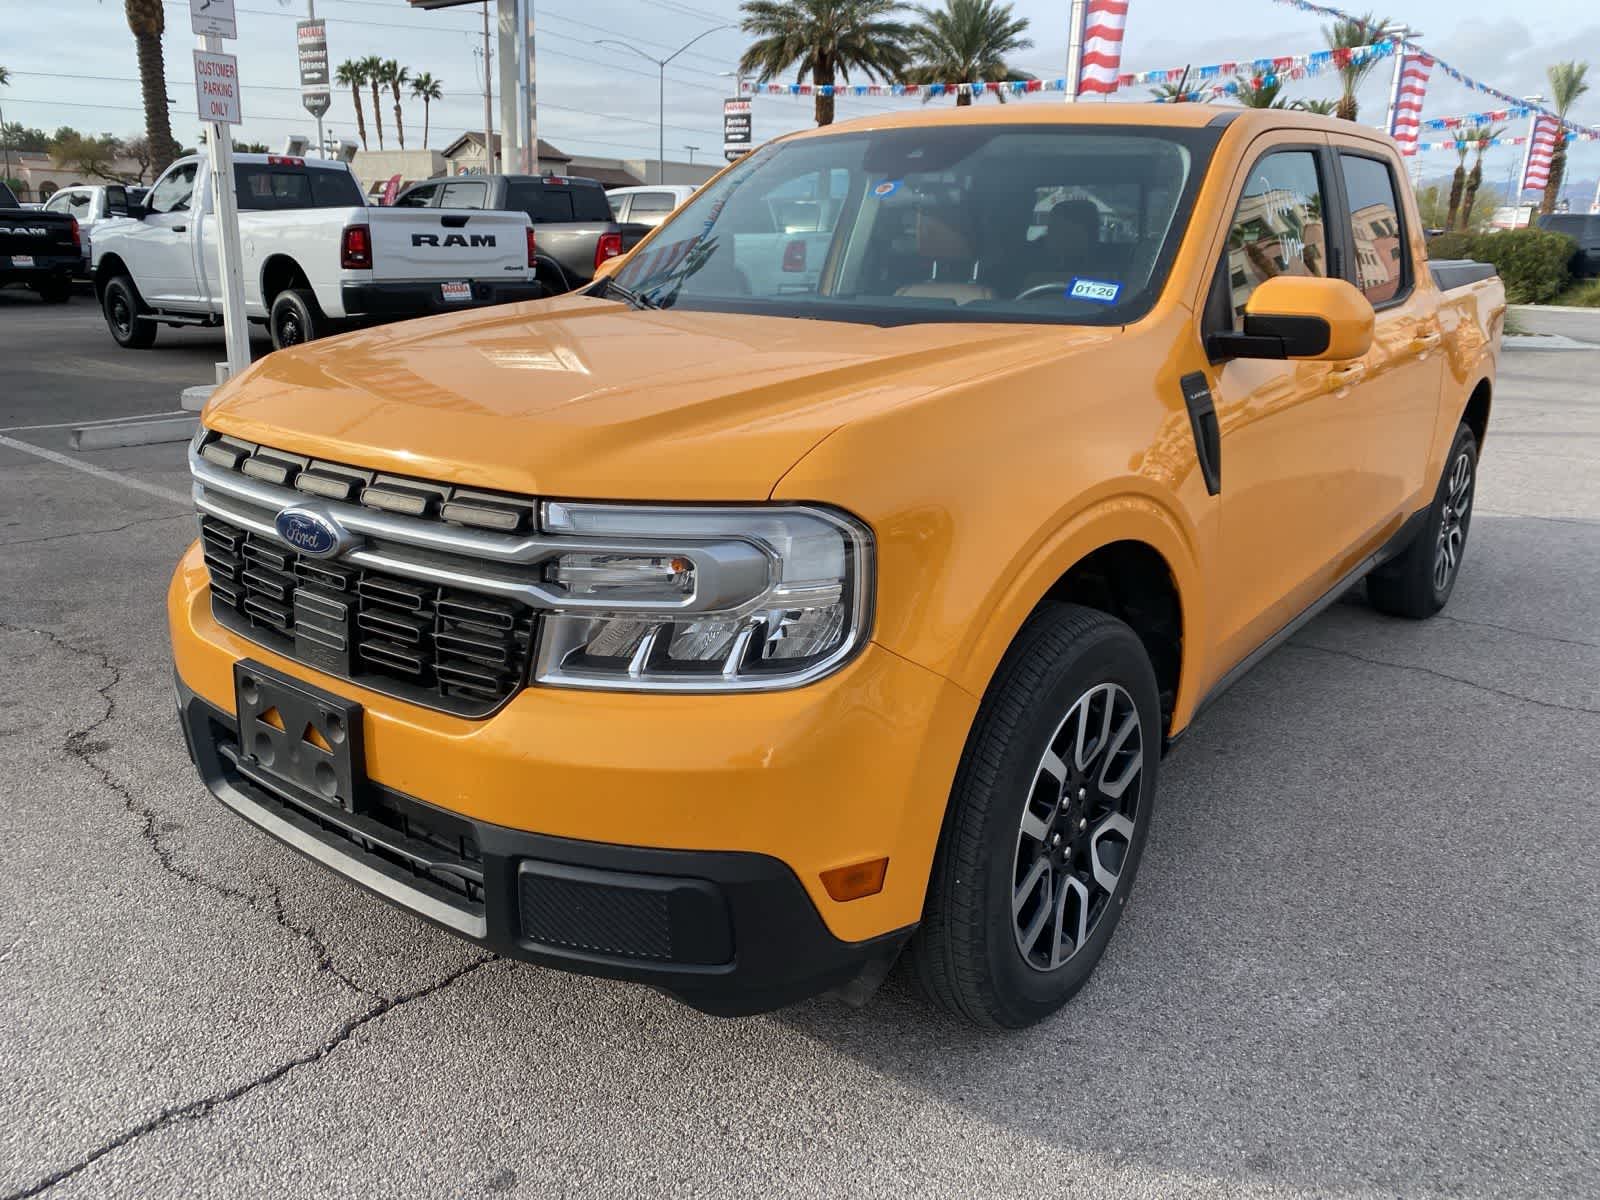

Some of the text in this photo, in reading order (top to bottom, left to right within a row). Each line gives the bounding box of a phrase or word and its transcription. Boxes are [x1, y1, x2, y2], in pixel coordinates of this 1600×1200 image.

[198, 60, 235, 79] CUSTOMER
[203, 81, 233, 98] PARKING
[210, 101, 229, 117] ONLY
[0, 227, 47, 236] RAM
[411, 234, 497, 248] RAM
[286, 519, 321, 548] Ford
